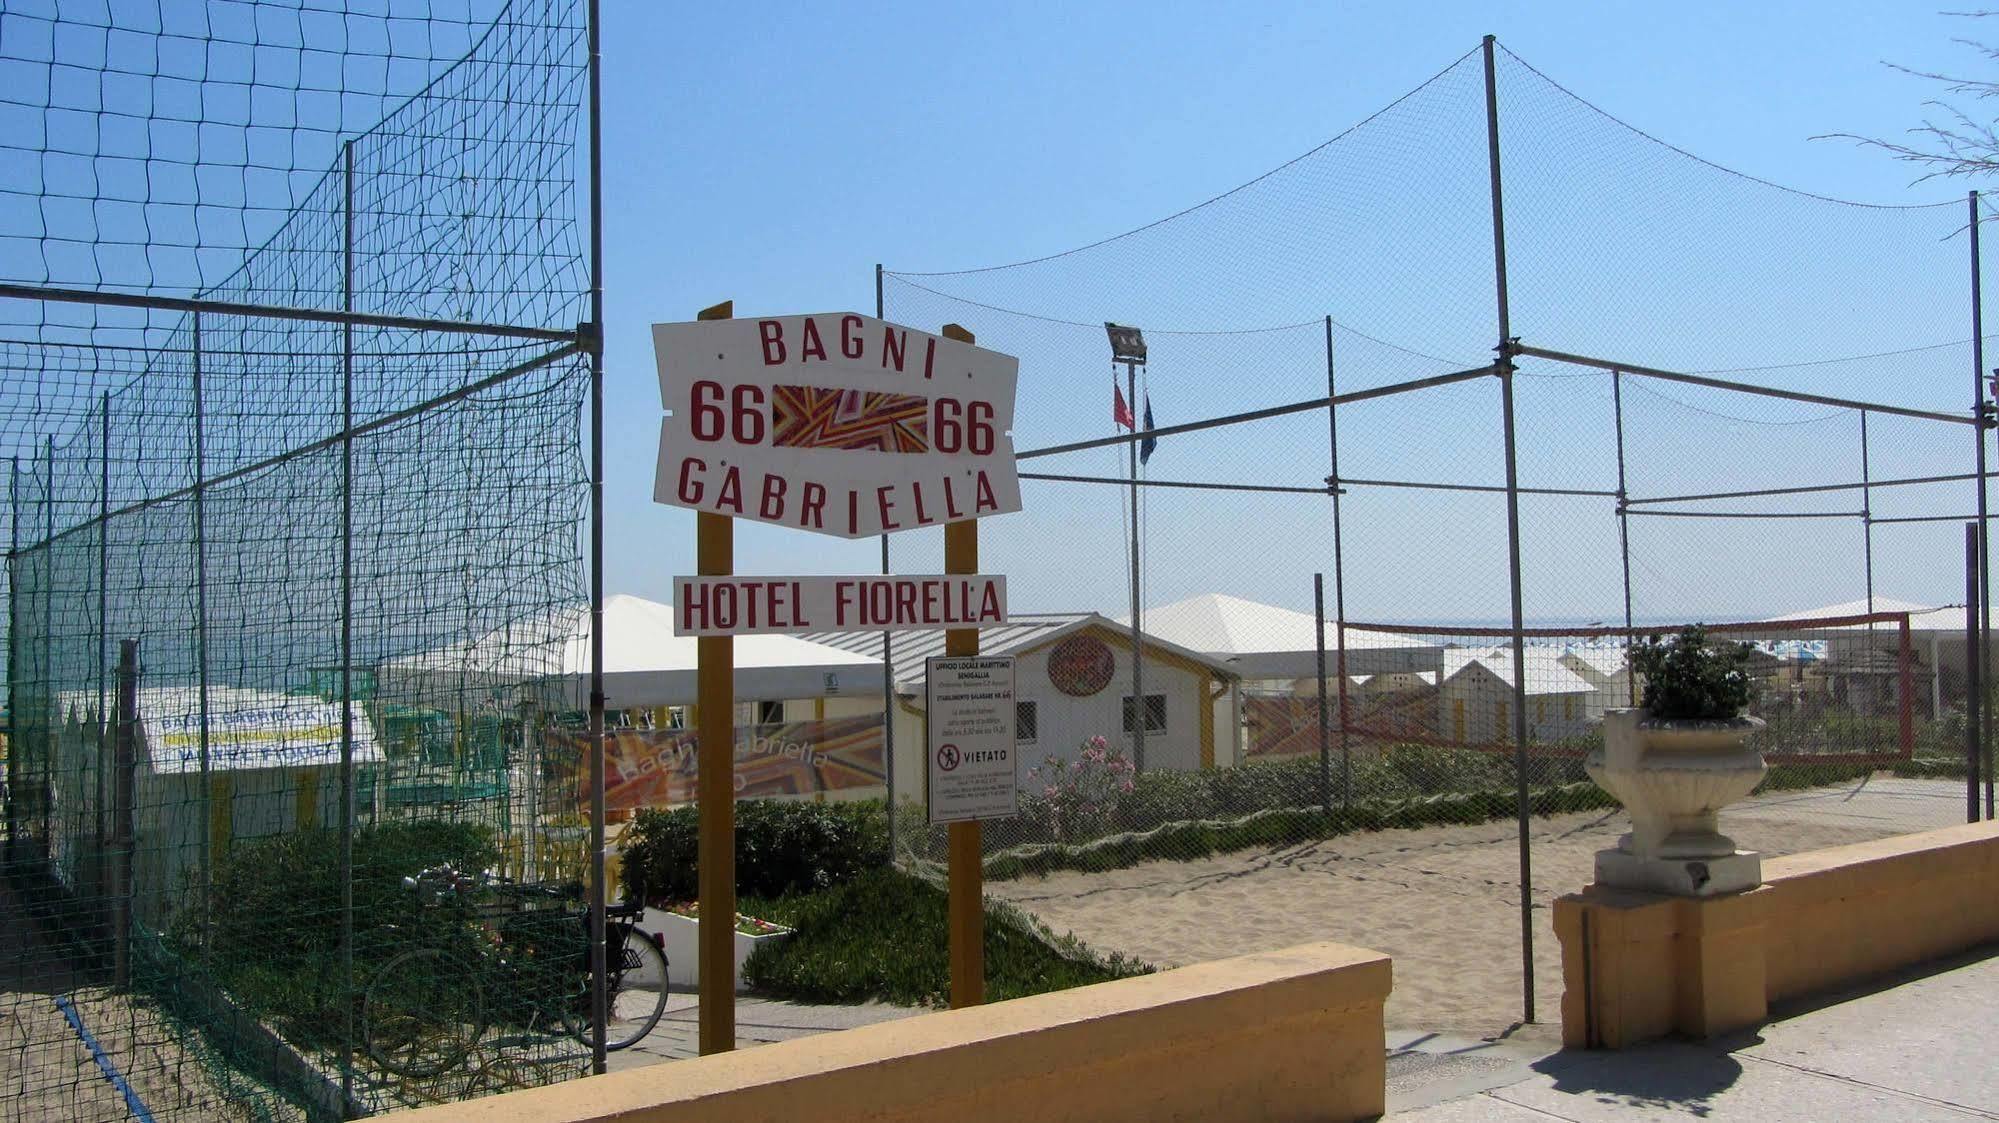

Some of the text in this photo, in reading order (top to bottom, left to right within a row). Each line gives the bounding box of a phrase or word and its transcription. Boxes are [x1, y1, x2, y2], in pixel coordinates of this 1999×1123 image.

[759, 315, 936, 380] BAGNI
[690, 380, 995, 456] 66 66
[677, 456, 998, 534] GABRIELLA
[683, 580, 1002, 630] HOTEL FIORELLA
[735, 735, 829, 769] abriella
[964, 750, 1007, 763] VIETATO
